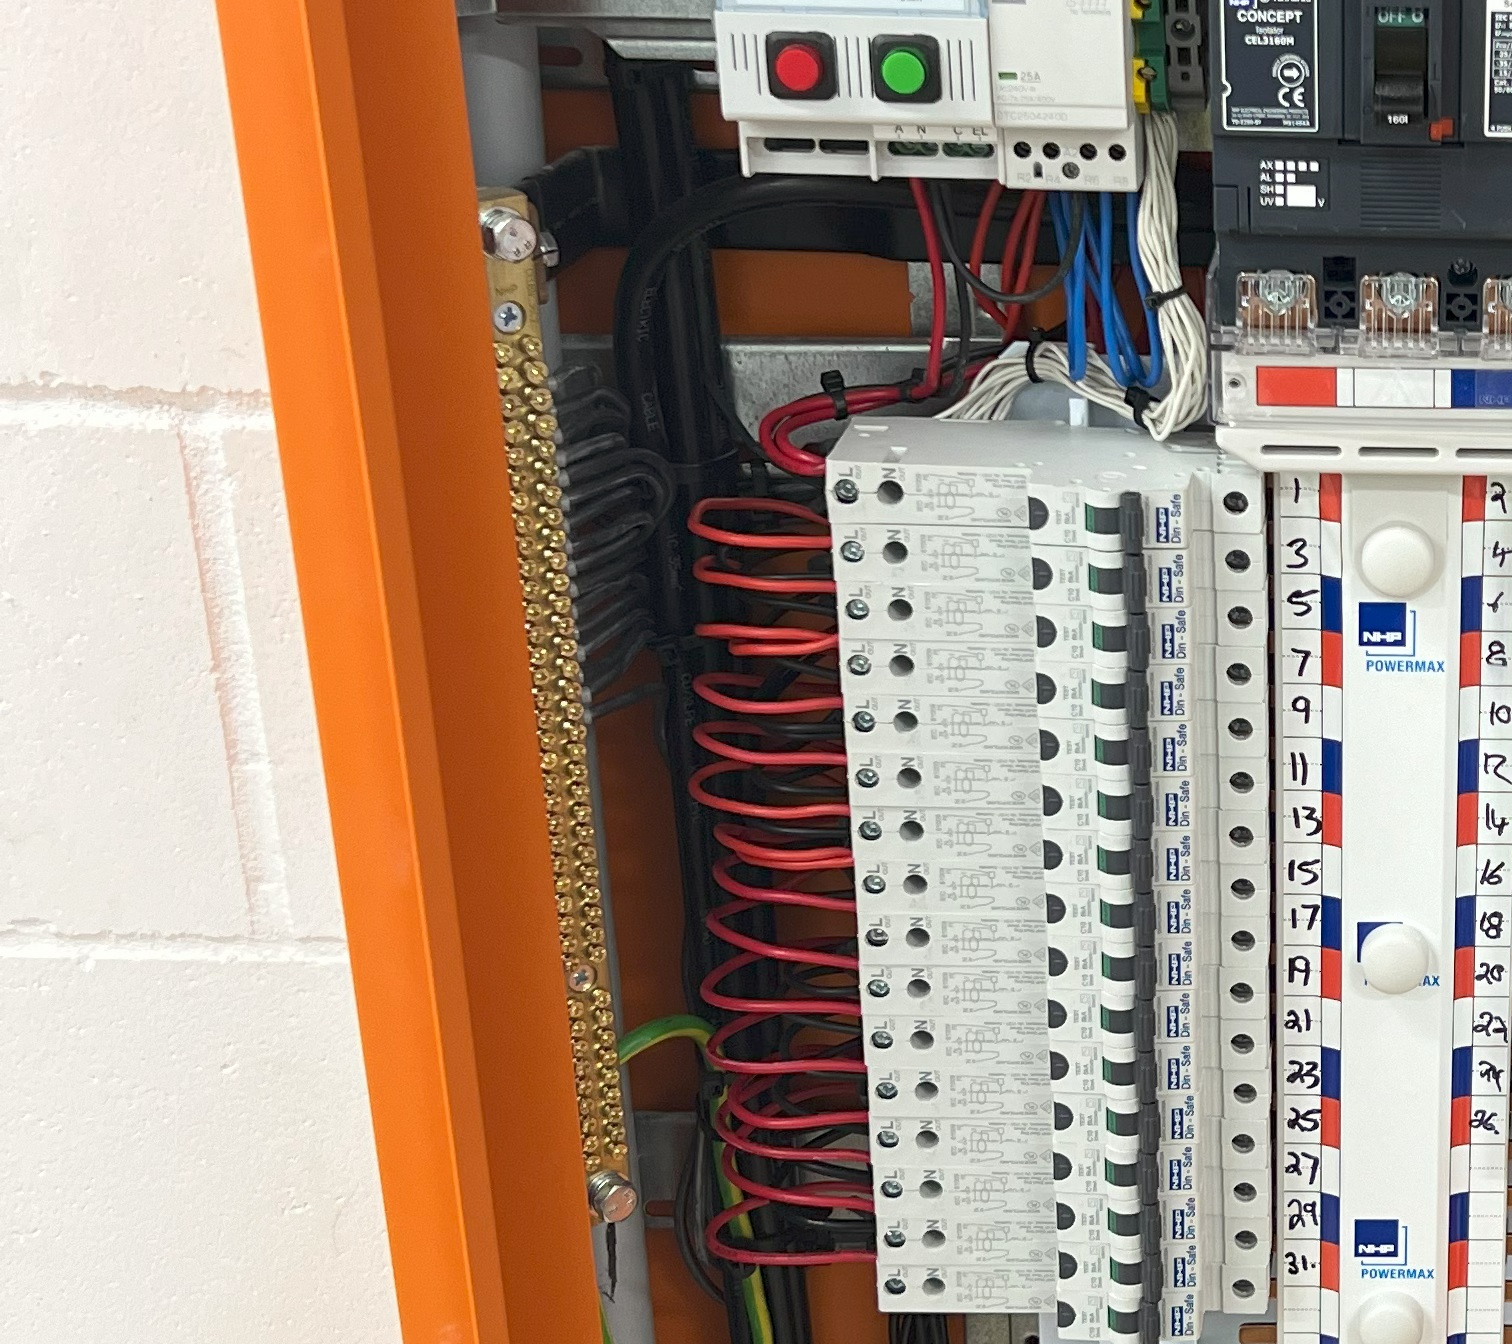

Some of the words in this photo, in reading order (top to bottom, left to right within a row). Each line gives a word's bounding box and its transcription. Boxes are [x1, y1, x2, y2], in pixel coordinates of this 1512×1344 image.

[1236, 9, 1303, 24] CONCEPT
[1260, 160, 1274, 170] AX
[1260, 172, 1272, 182] AL
[1260, 184, 1274, 194] SH
[1260, 196, 1274, 206] UV
[1317, 197, 1325, 208] V
[1293, 477, 1300, 503] 1
[1285, 537, 1309, 569] 3
[1286, 589, 1320, 617] 5
[1361, 630, 1403, 644] NHP
[1291, 647, 1312, 677] 7
[1365, 659, 1446, 674] POWERMAX
[1486, 640, 1508, 667] 8
[1291, 696, 1311, 724] 9
[1489, 701, 1512, 726] 10
[1291, 751, 1308, 786] 11
[1292, 806, 1322, 836] 13
[1485, 803, 1509, 836] 14
[1180, 835, 1191, 857] Safe
[1181, 866, 1191, 881] Din
[1287, 859, 1320, 886] 15
[1479, 859, 1506, 885] 16
[1291, 904, 1321, 931] 17
[1479, 911, 1504, 940] 18
[1474, 961, 1506, 985] 20
[1284, 1008, 1311, 1033] 21
[1286, 1061, 1321, 1089] 23
[1286, 1106, 1322, 1132] 25
[1284, 1151, 1320, 1185] 27
[1287, 1199, 1317, 1230] 29
[1357, 1242, 1395, 1255] NHP
[1361, 1268, 1435, 1280] POWERMAX
[1184, 1294, 1194, 1314] Safe
[1185, 1322, 1194, 1336] Din
